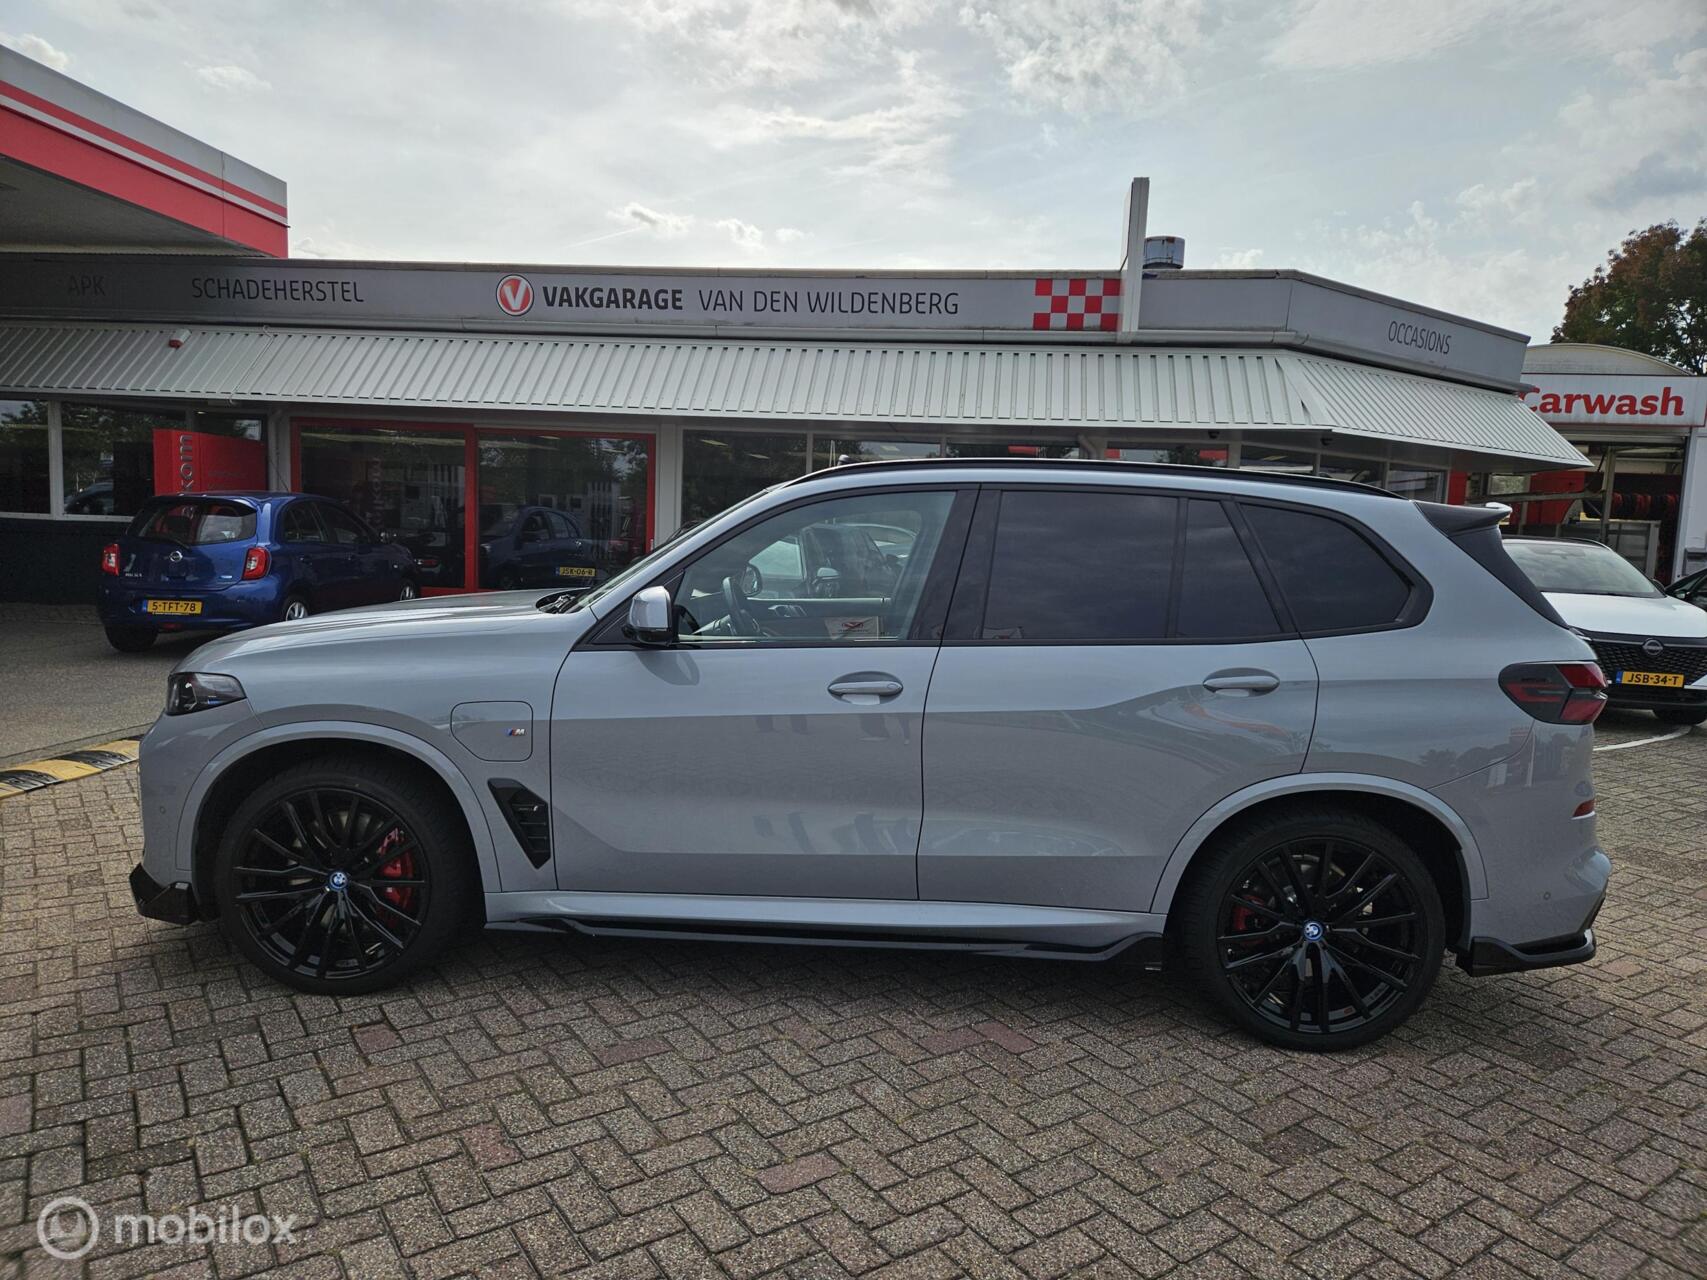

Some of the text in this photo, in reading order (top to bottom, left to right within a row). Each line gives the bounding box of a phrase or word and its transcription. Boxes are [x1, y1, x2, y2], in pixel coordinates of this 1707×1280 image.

[67, 274, 106, 297] APK
[191, 278, 364, 303] SCHADEHERSTEL
[542, 286, 960, 316] VAKGARAGE VAN DEN WILDENBERG
[1388, 320, 1452, 355] OCCASIONS
[152, 602, 196, 611] 5-TFT-78
[1627, 673, 1680, 685] JSB-34-T
